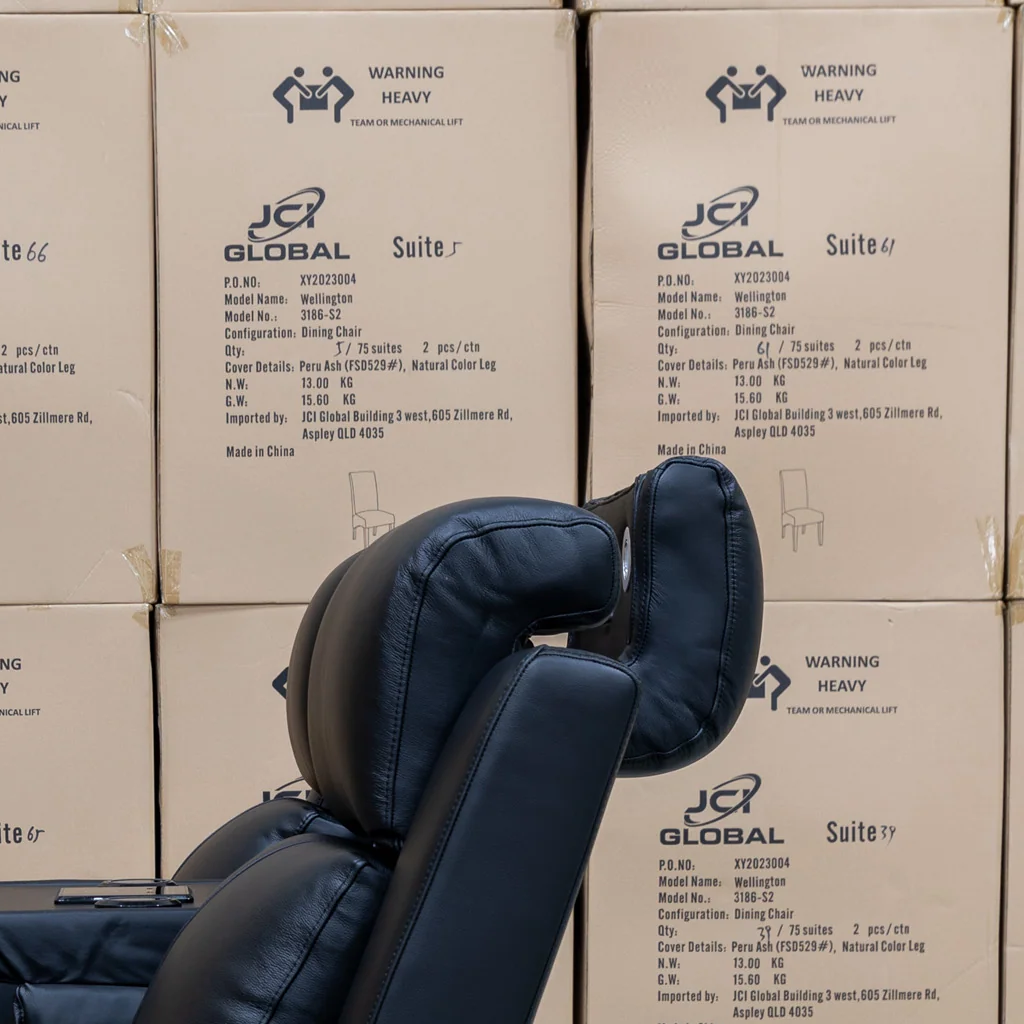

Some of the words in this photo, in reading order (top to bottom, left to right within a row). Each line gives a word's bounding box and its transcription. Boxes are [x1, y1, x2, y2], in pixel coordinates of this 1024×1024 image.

[368, 66, 443, 79] WARNING
[800, 63, 876, 77] WARNING
[382, 91, 431, 103] HEAVY
[814, 89, 863, 101] HEAVY
[350, 118, 374, 126] TEAM
[375, 118, 388, 126] OR
[390, 118, 444, 126] MECHANICAL
[782, 117, 807, 125] TEAM
[822, 116, 876, 124] MECHANICAL
[879, 115, 895, 123] LIFT
[223, 242, 350, 261] GLOBAL
[392, 235, 443, 258] Suite
[657, 240, 783, 260] GLOBAL
[826, 233, 876, 255] Suite
[881, 237, 895, 256] 61
[27, 241, 49, 263] 66
[734, 270, 789, 283] XY2023004
[224, 310, 253, 322] Model
[257, 310, 276, 321] No.:
[300, 308, 341, 320] 3186-S2
[224, 326, 295, 341] Configuration:
[301, 325, 333, 339] Dining
[335, 325, 361, 337] Chair
[29, 361, 55, 373] Color
[58, 361, 75, 374] Leg
[657, 376, 680, 388] N.W:
[734, 374, 761, 386] 13.00
[773, 374, 785, 386] KG
[657, 393, 679, 405] G.W:
[734, 391, 761, 403] 15.60
[775, 391, 787, 403] KG
[805, 655, 879, 668] WARNING
[818, 679, 866, 691] HEAVY
[787, 706, 810, 714] TEAM
[811, 706, 824, 714] OR
[659, 827, 784, 845] GLOBAL
[826, 820, 876, 843] Suite
[658, 875, 688, 887] Model
[690, 875, 721, 886] Name:
[734, 876, 785, 889] Wellington
[658, 892, 687, 903] Model
[690, 892, 710, 903] No.:
[733, 891, 773, 903] 3186-S2
[732, 1006, 764, 1019] Aspley
[767, 1006, 785, 1017] QLD
[788, 1005, 813, 1017] 4035
